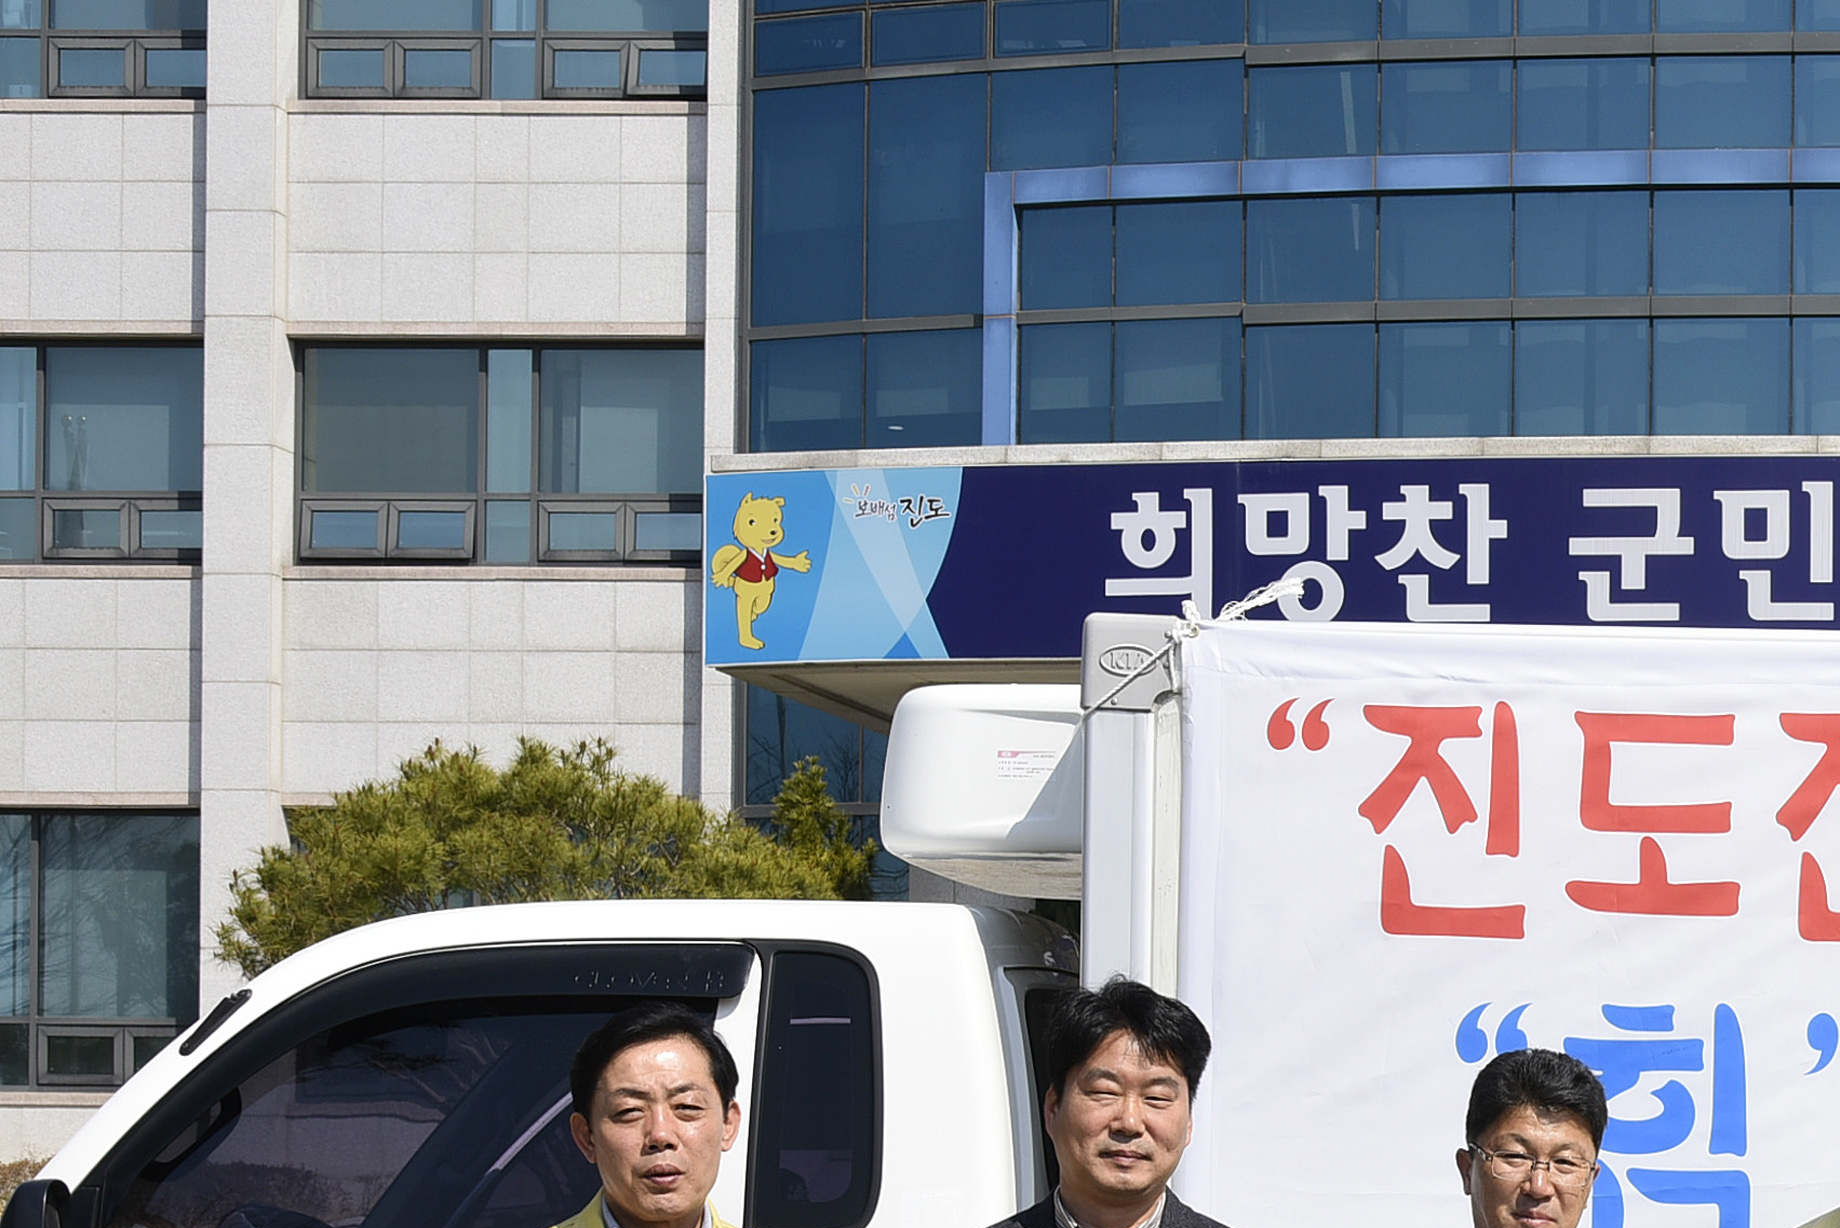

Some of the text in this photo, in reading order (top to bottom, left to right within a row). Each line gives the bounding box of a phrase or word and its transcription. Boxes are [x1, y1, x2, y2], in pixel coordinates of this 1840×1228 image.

[899, 495, 951, 528] 진도
[1104, 484, 1508, 624] 희망찬
[1568, 482, 1836, 624] 군민
[1110, 652, 1149, 670] KIA
